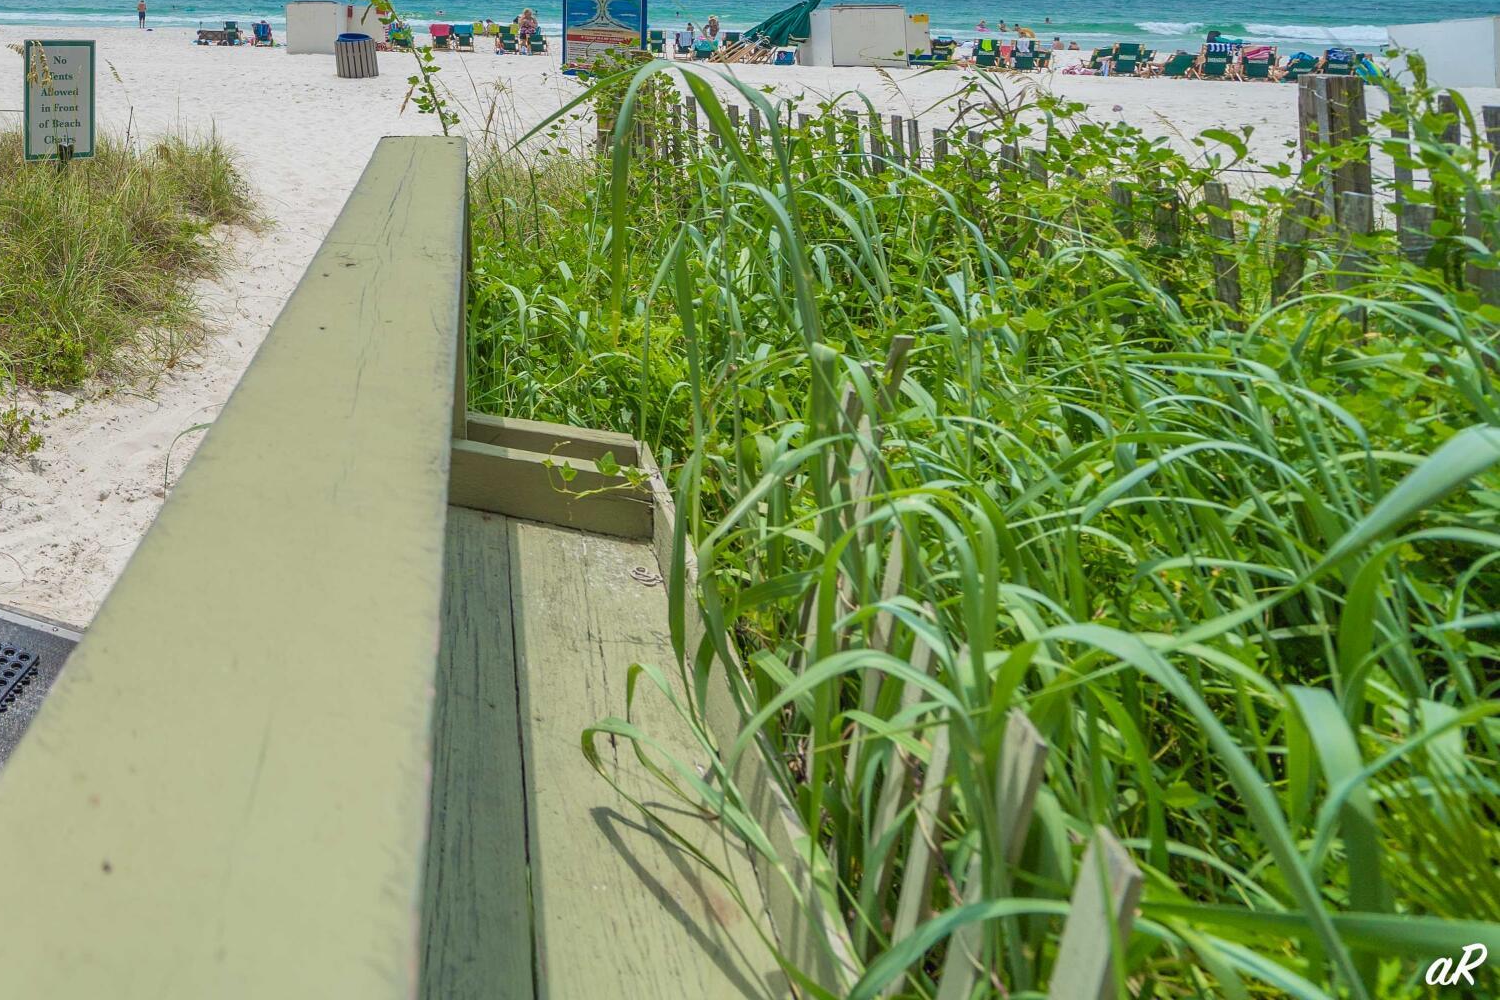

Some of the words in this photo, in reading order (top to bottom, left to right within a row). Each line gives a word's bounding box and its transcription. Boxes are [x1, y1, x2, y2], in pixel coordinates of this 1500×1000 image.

[53, 55, 67, 65] No
[41, 103, 51, 113] in
[54, 103, 79, 112] Front
[38, 119, 49, 129] of
[52, 119, 81, 128] Beach
[44, 135, 77, 145] Chairs
